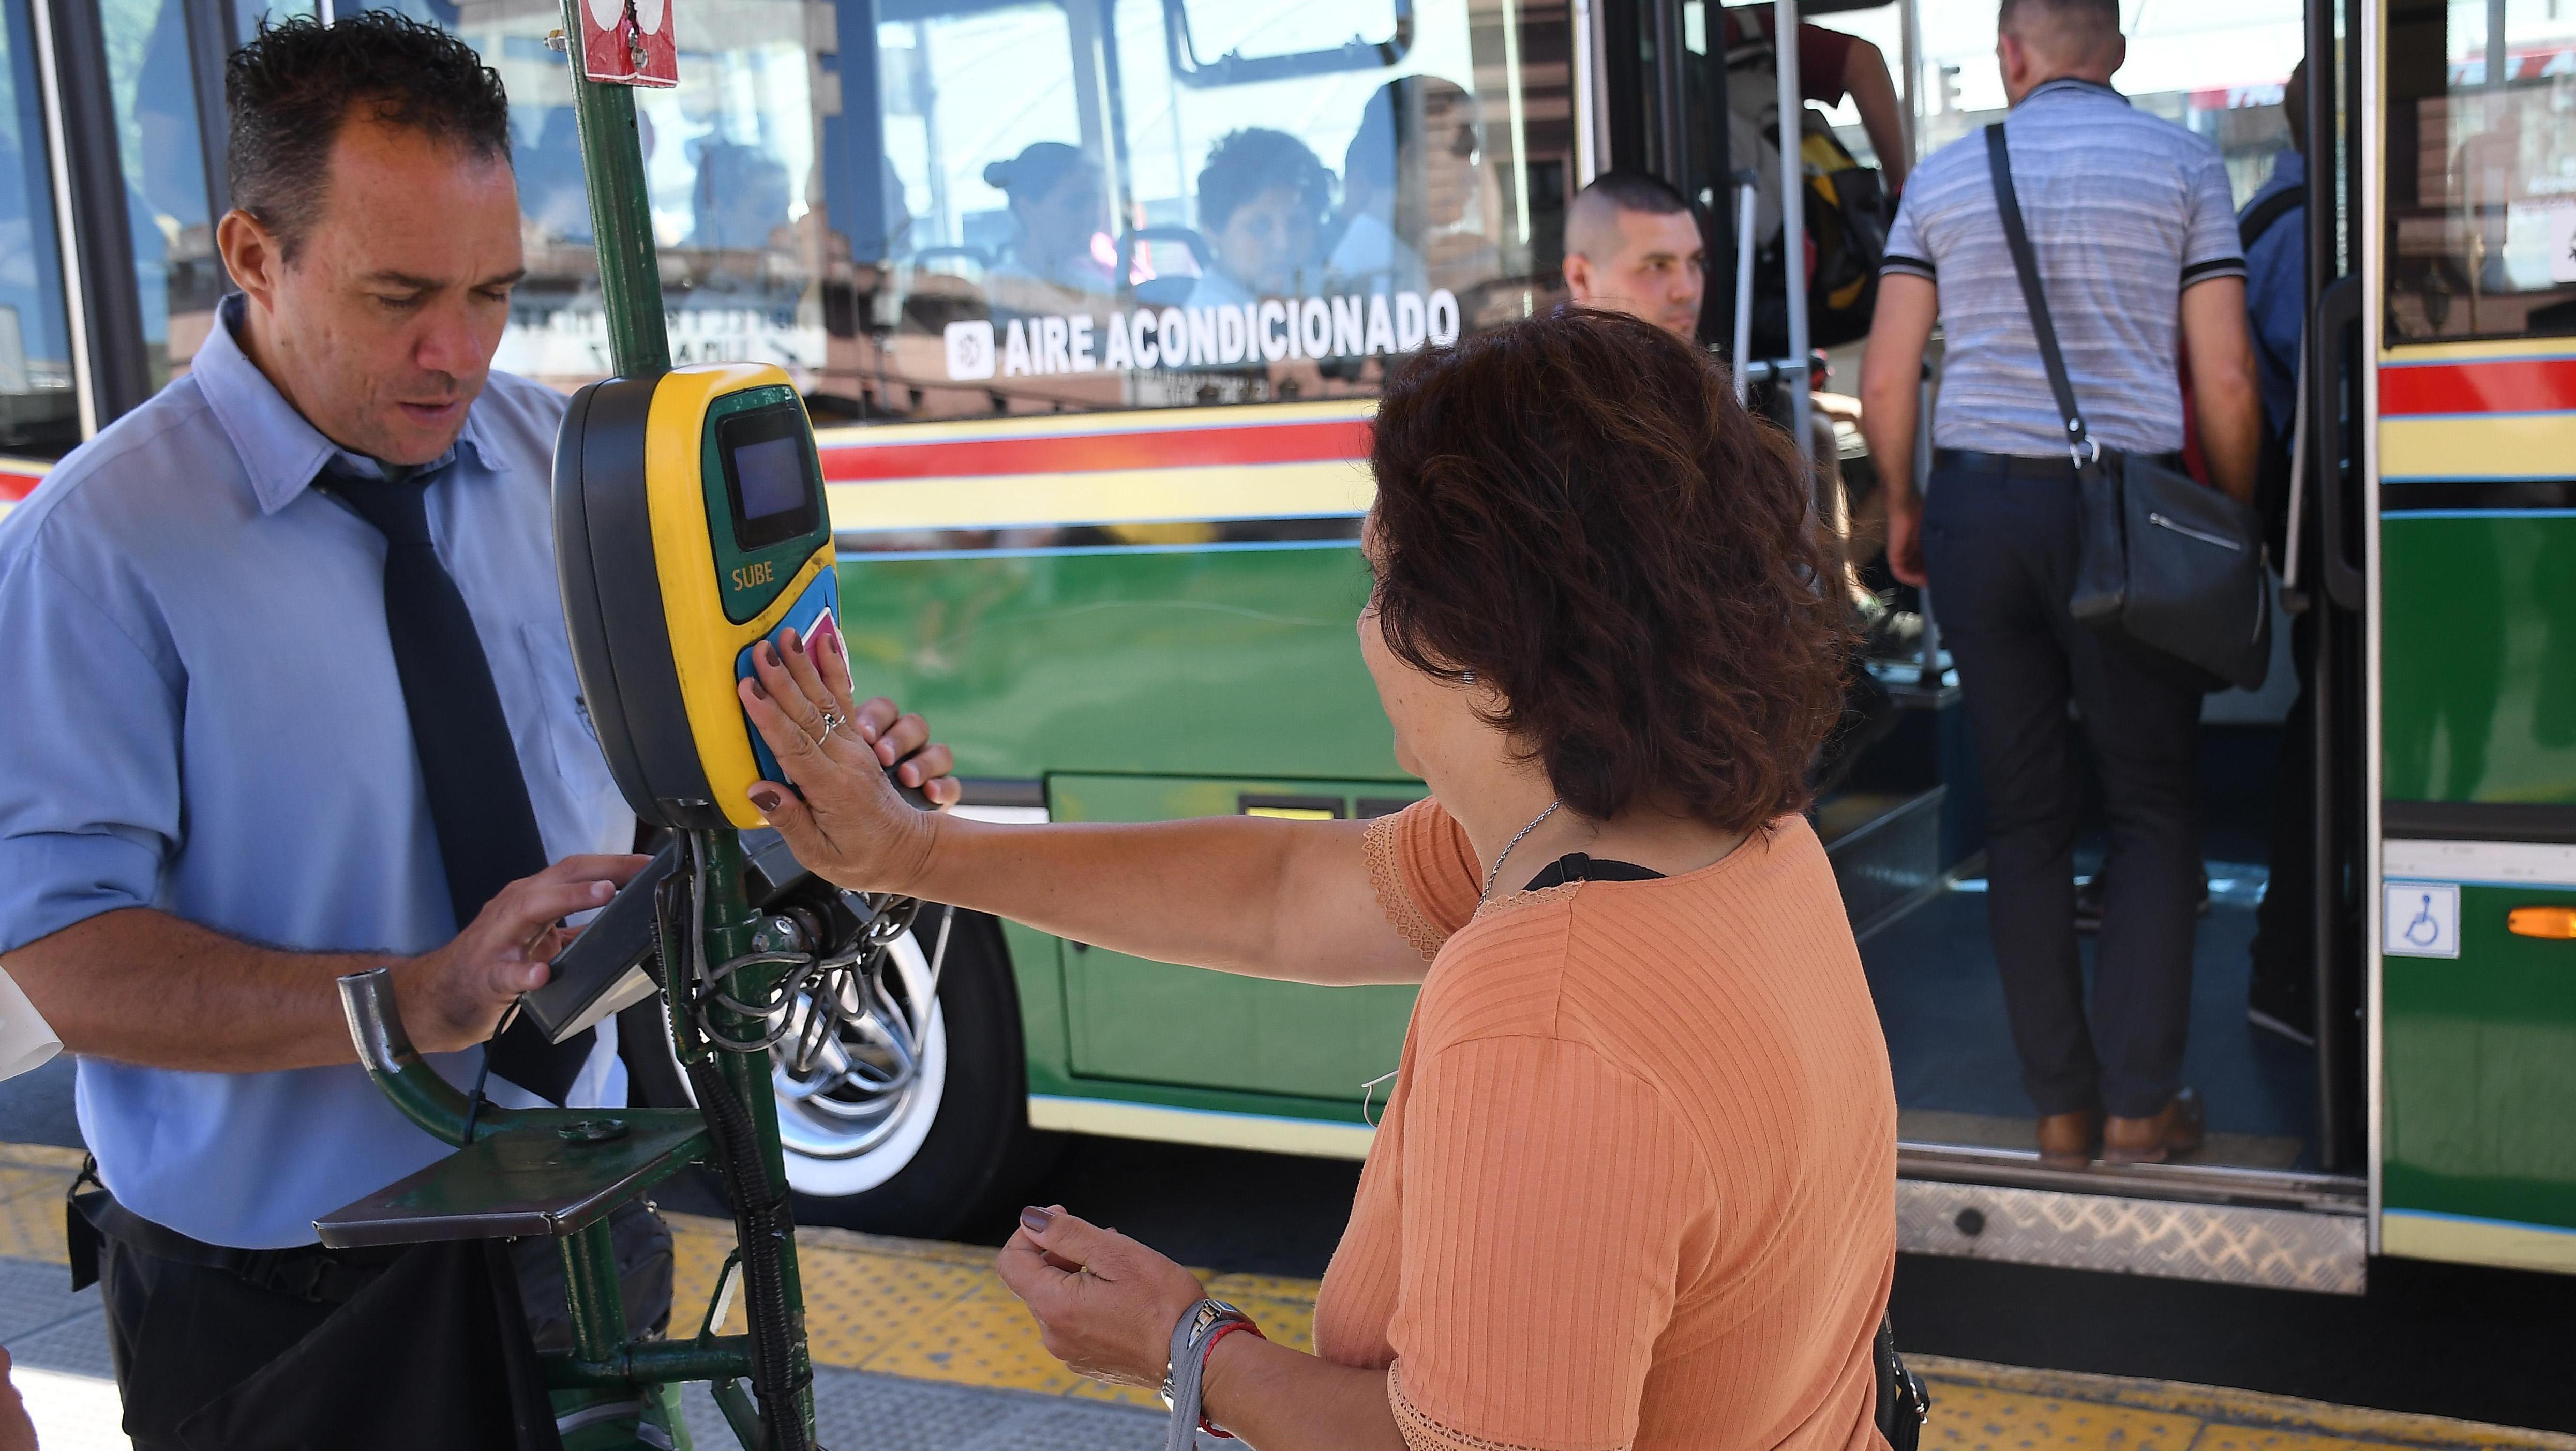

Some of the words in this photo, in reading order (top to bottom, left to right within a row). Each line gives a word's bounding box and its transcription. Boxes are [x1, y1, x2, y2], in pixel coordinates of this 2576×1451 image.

[1004, 314, 1097, 377] AIRE
[1105, 288, 1461, 370] ACONDICIONADO
[732, 561, 774, 591] SUBE
